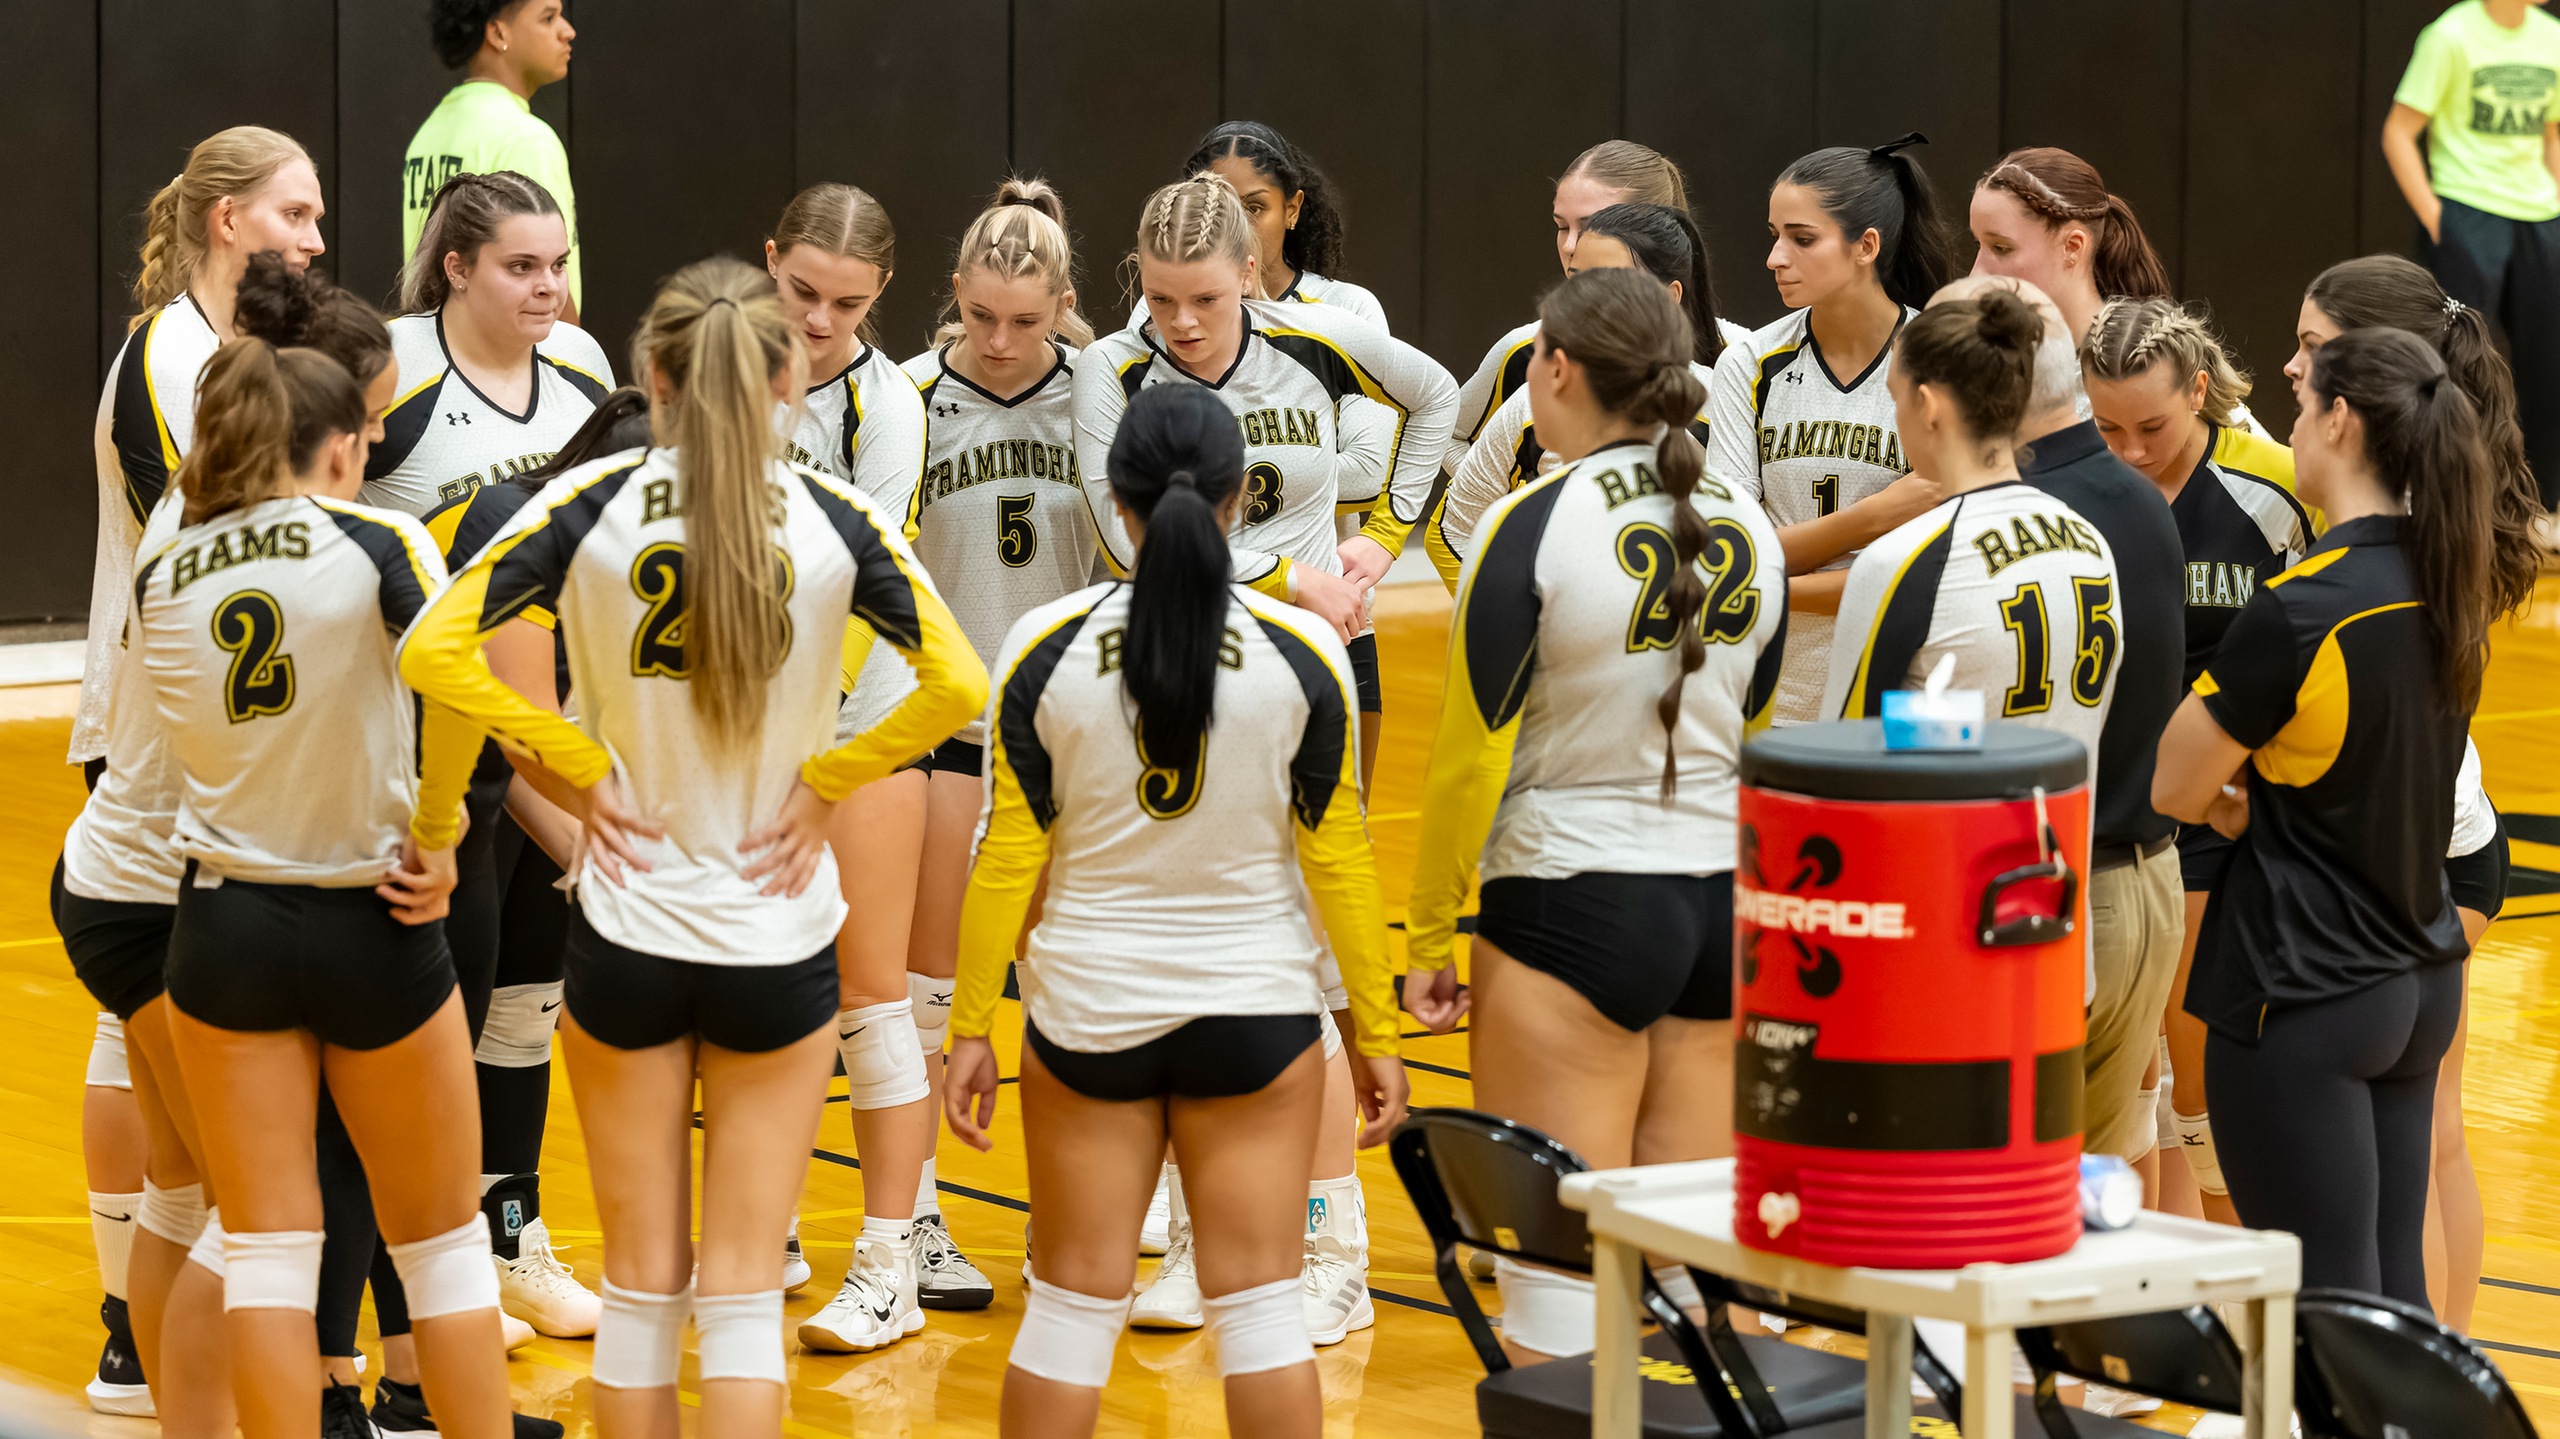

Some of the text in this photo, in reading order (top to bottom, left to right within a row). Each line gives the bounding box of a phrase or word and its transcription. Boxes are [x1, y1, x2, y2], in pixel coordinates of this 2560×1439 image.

[2470, 97, 2547, 135] RAM
[924, 439, 1083, 507] FRAMINGHA
[1243, 461, 1284, 527] 3
[1812, 474, 1839, 518] 1
[171, 521, 310, 597] RAMS
[997, 491, 1038, 569] 5
[1971, 513, 2103, 578] RAMS
[1615, 516, 1761, 654] 22
[211, 588, 296, 724] 2
[1998, 573, 2119, 719] 15
